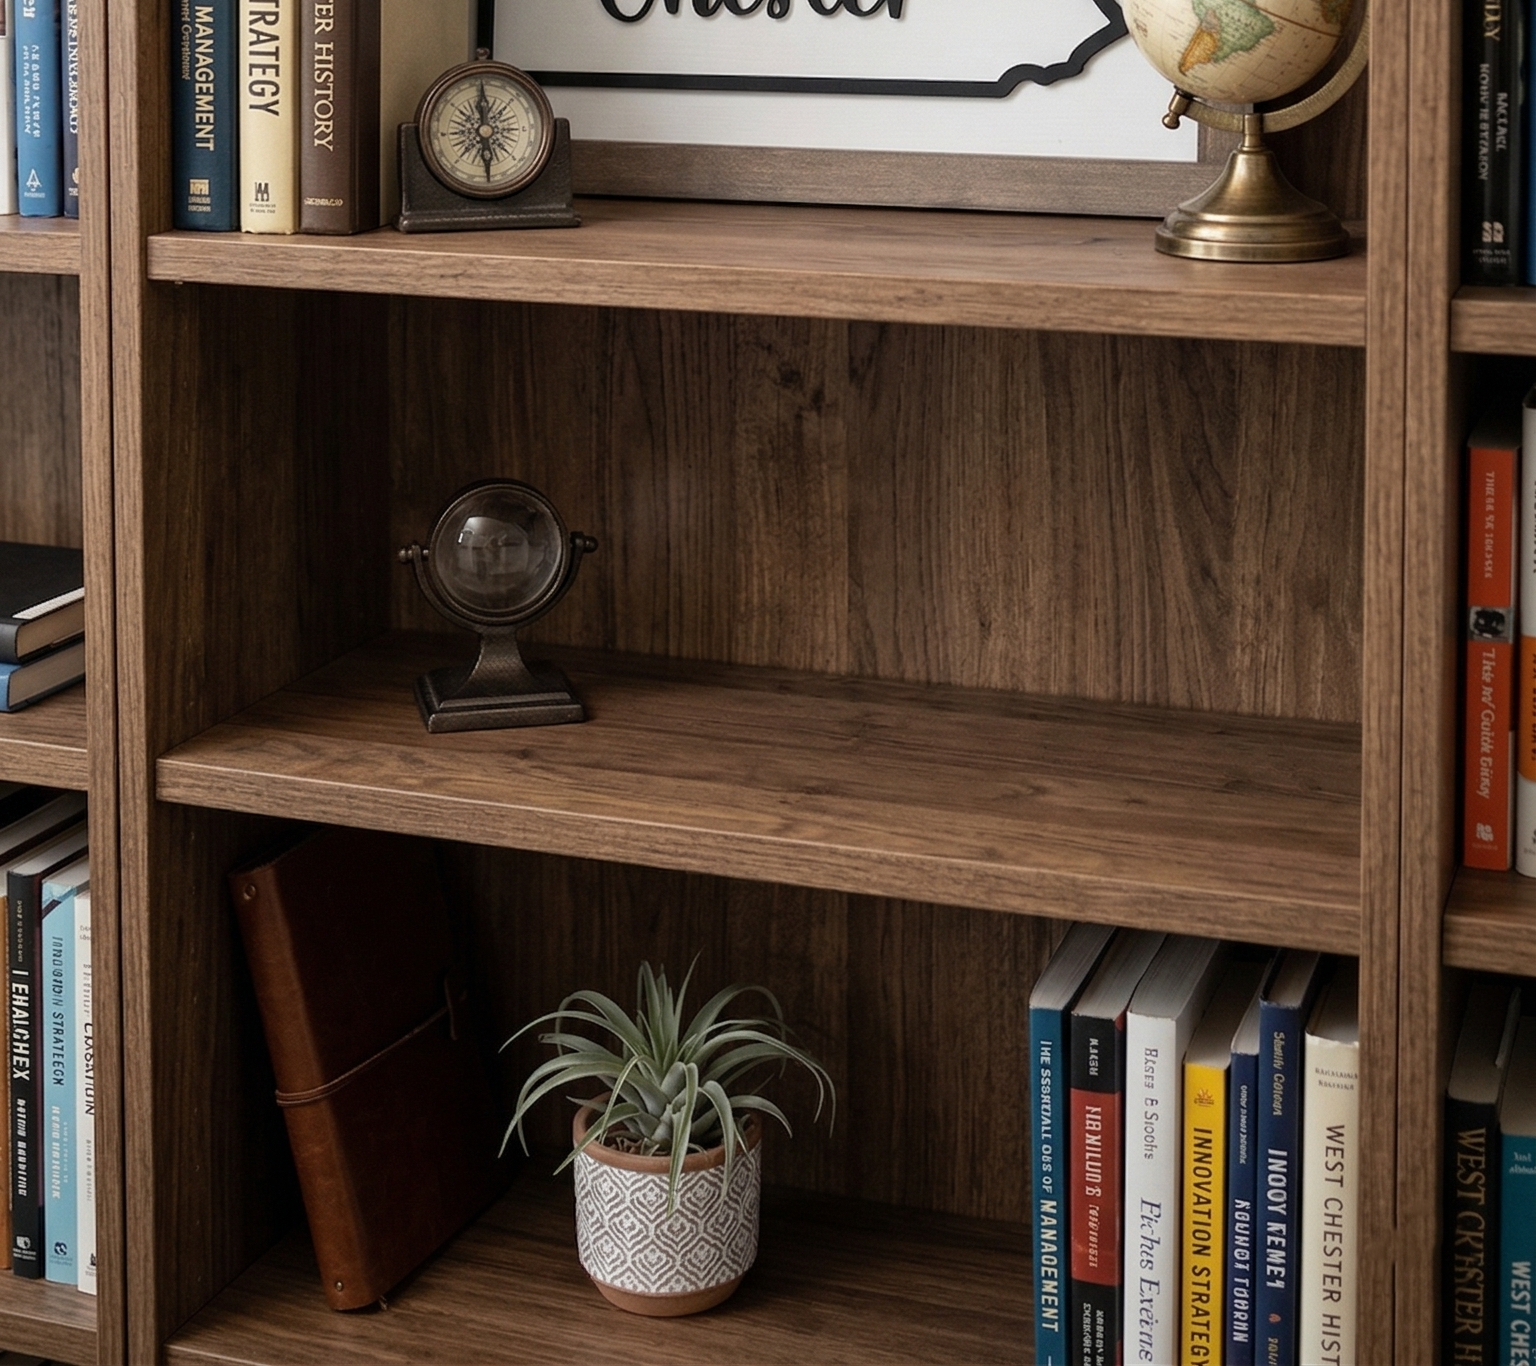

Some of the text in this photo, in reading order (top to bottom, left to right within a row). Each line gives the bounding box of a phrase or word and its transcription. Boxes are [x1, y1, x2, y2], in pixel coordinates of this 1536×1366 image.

[194, 5, 214, 152] MANAGEMENT
[313, 42, 334, 152] HISTORY
[1042, 1176, 1053, 1194] OF
[1456, 1127, 1486, 1205] WEST
[1190, 1127, 1212, 1366] INNOVATION STRATEGY
[1321, 1125, 1345, 1366] WEST CHESTER HIST
[1510, 1261, 1531, 1366] WEST CHES
